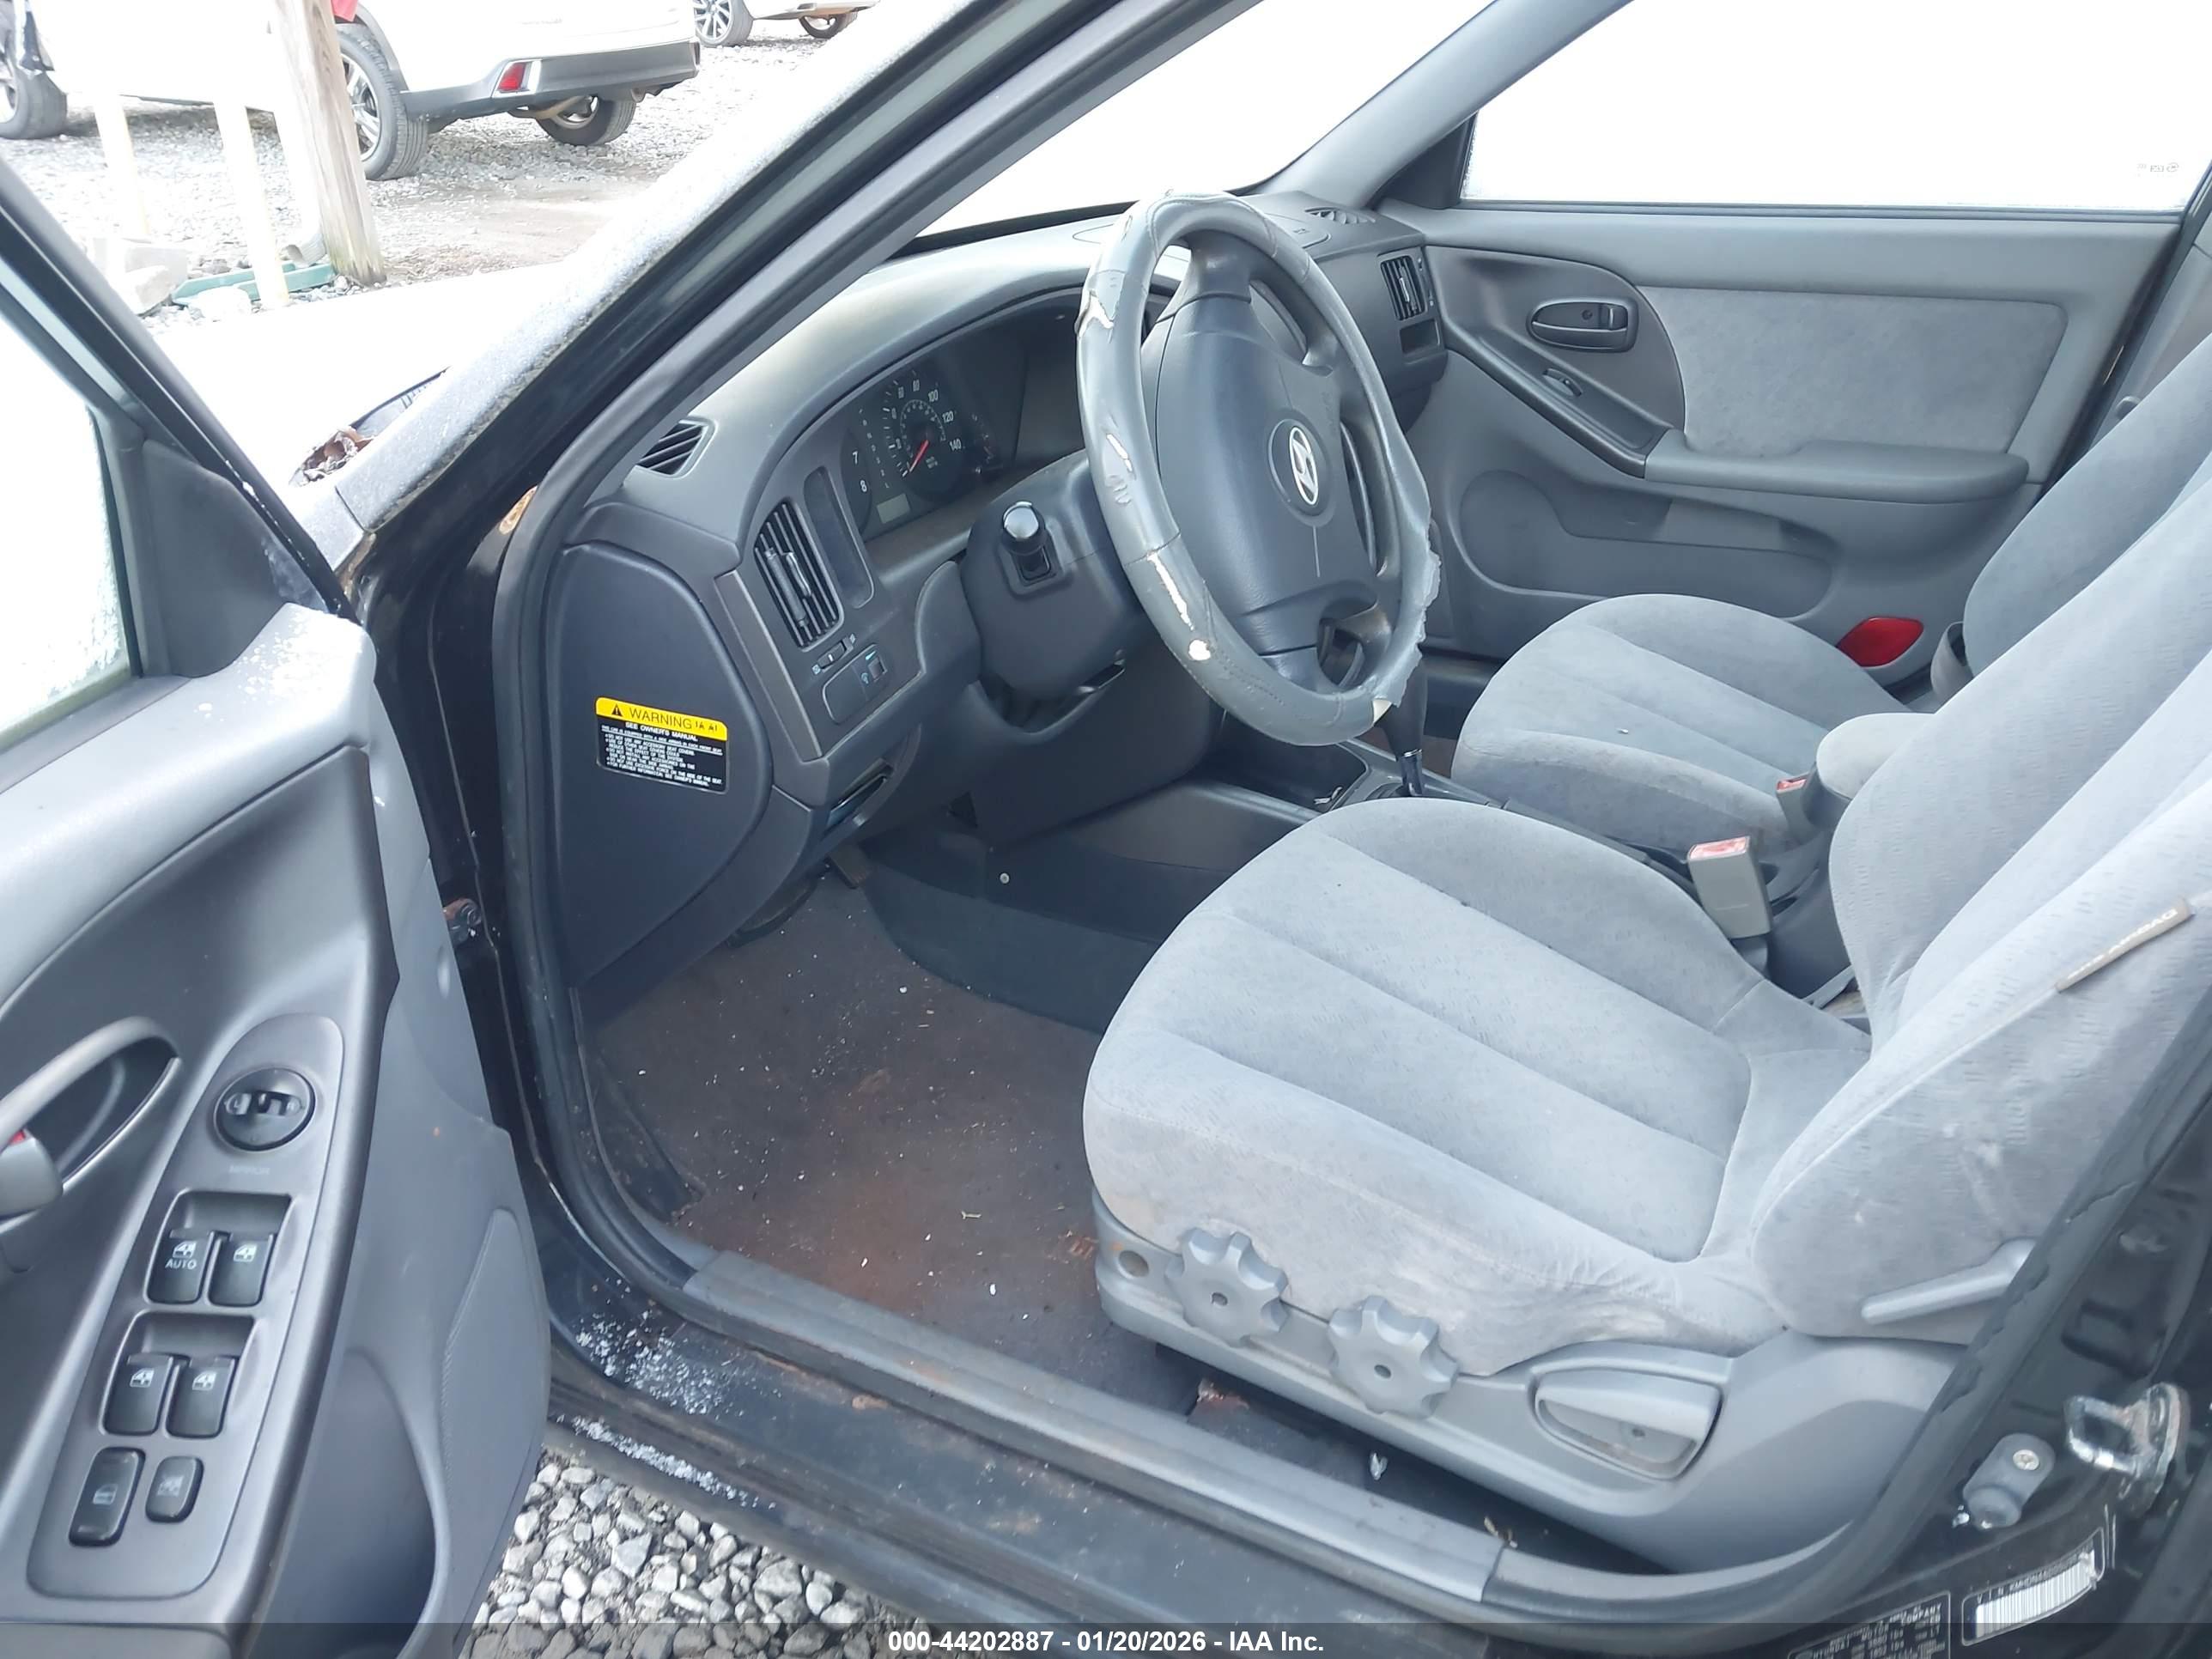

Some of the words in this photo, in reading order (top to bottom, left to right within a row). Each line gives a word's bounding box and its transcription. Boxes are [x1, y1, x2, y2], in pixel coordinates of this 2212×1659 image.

[927, 388, 939, 402] 100
[942, 410, 954, 422] 120
[949, 438, 962, 452] 140
[852, 450, 859, 465] 7
[860, 479, 867, 493] 8
[629, 707, 692, 730] WARNING
[626, 721, 638, 730] SEE
[641, 724, 670, 736] OWNER'S
[165, 1259, 198, 1271] AUTO
